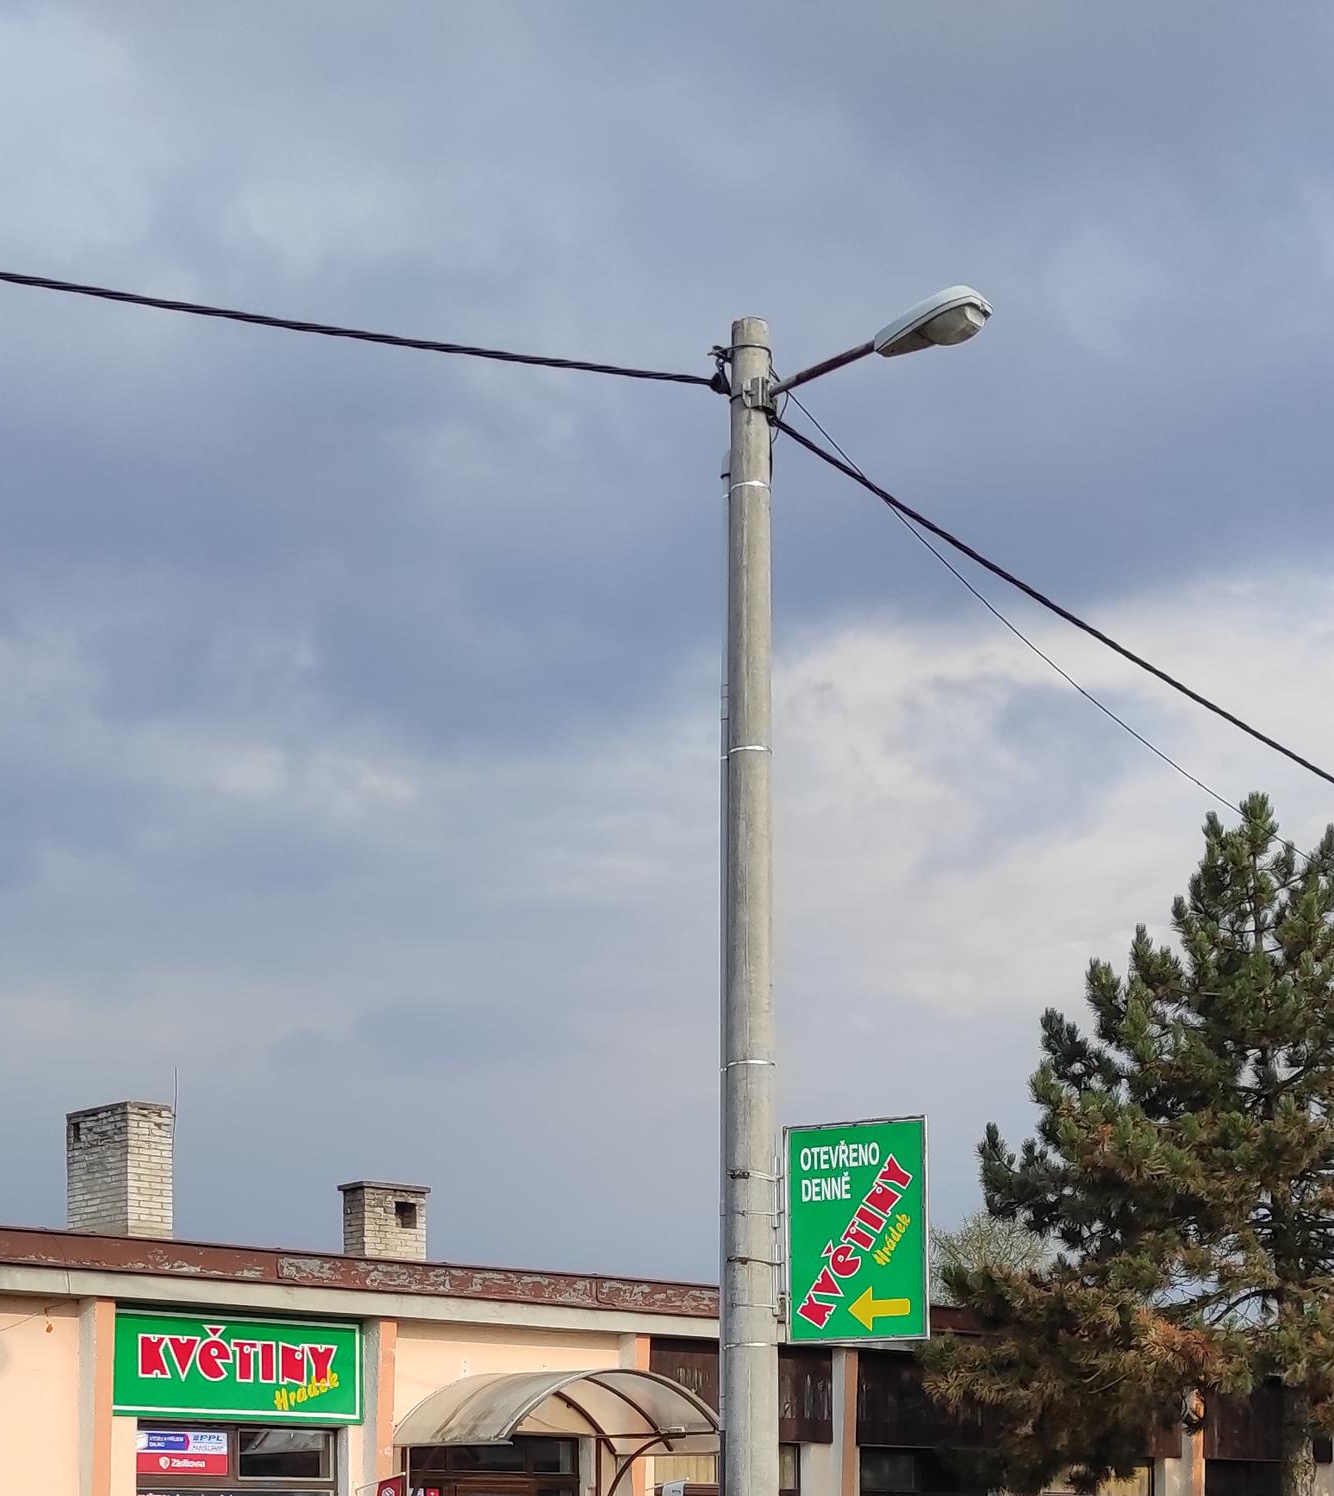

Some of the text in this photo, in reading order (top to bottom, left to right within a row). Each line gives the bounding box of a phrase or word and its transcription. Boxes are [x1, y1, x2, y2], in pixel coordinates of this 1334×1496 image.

[800, 1140, 880, 1172] OTEVŘENO
[801, 1172, 851, 1203] DENNĚ
[796, 1153, 913, 1329] KVĚTINY
[871, 1213, 911, 1266] Hrádek
[138, 1324, 338, 1387] KVĚTINY
[273, 1367, 340, 1411] Hrádek
